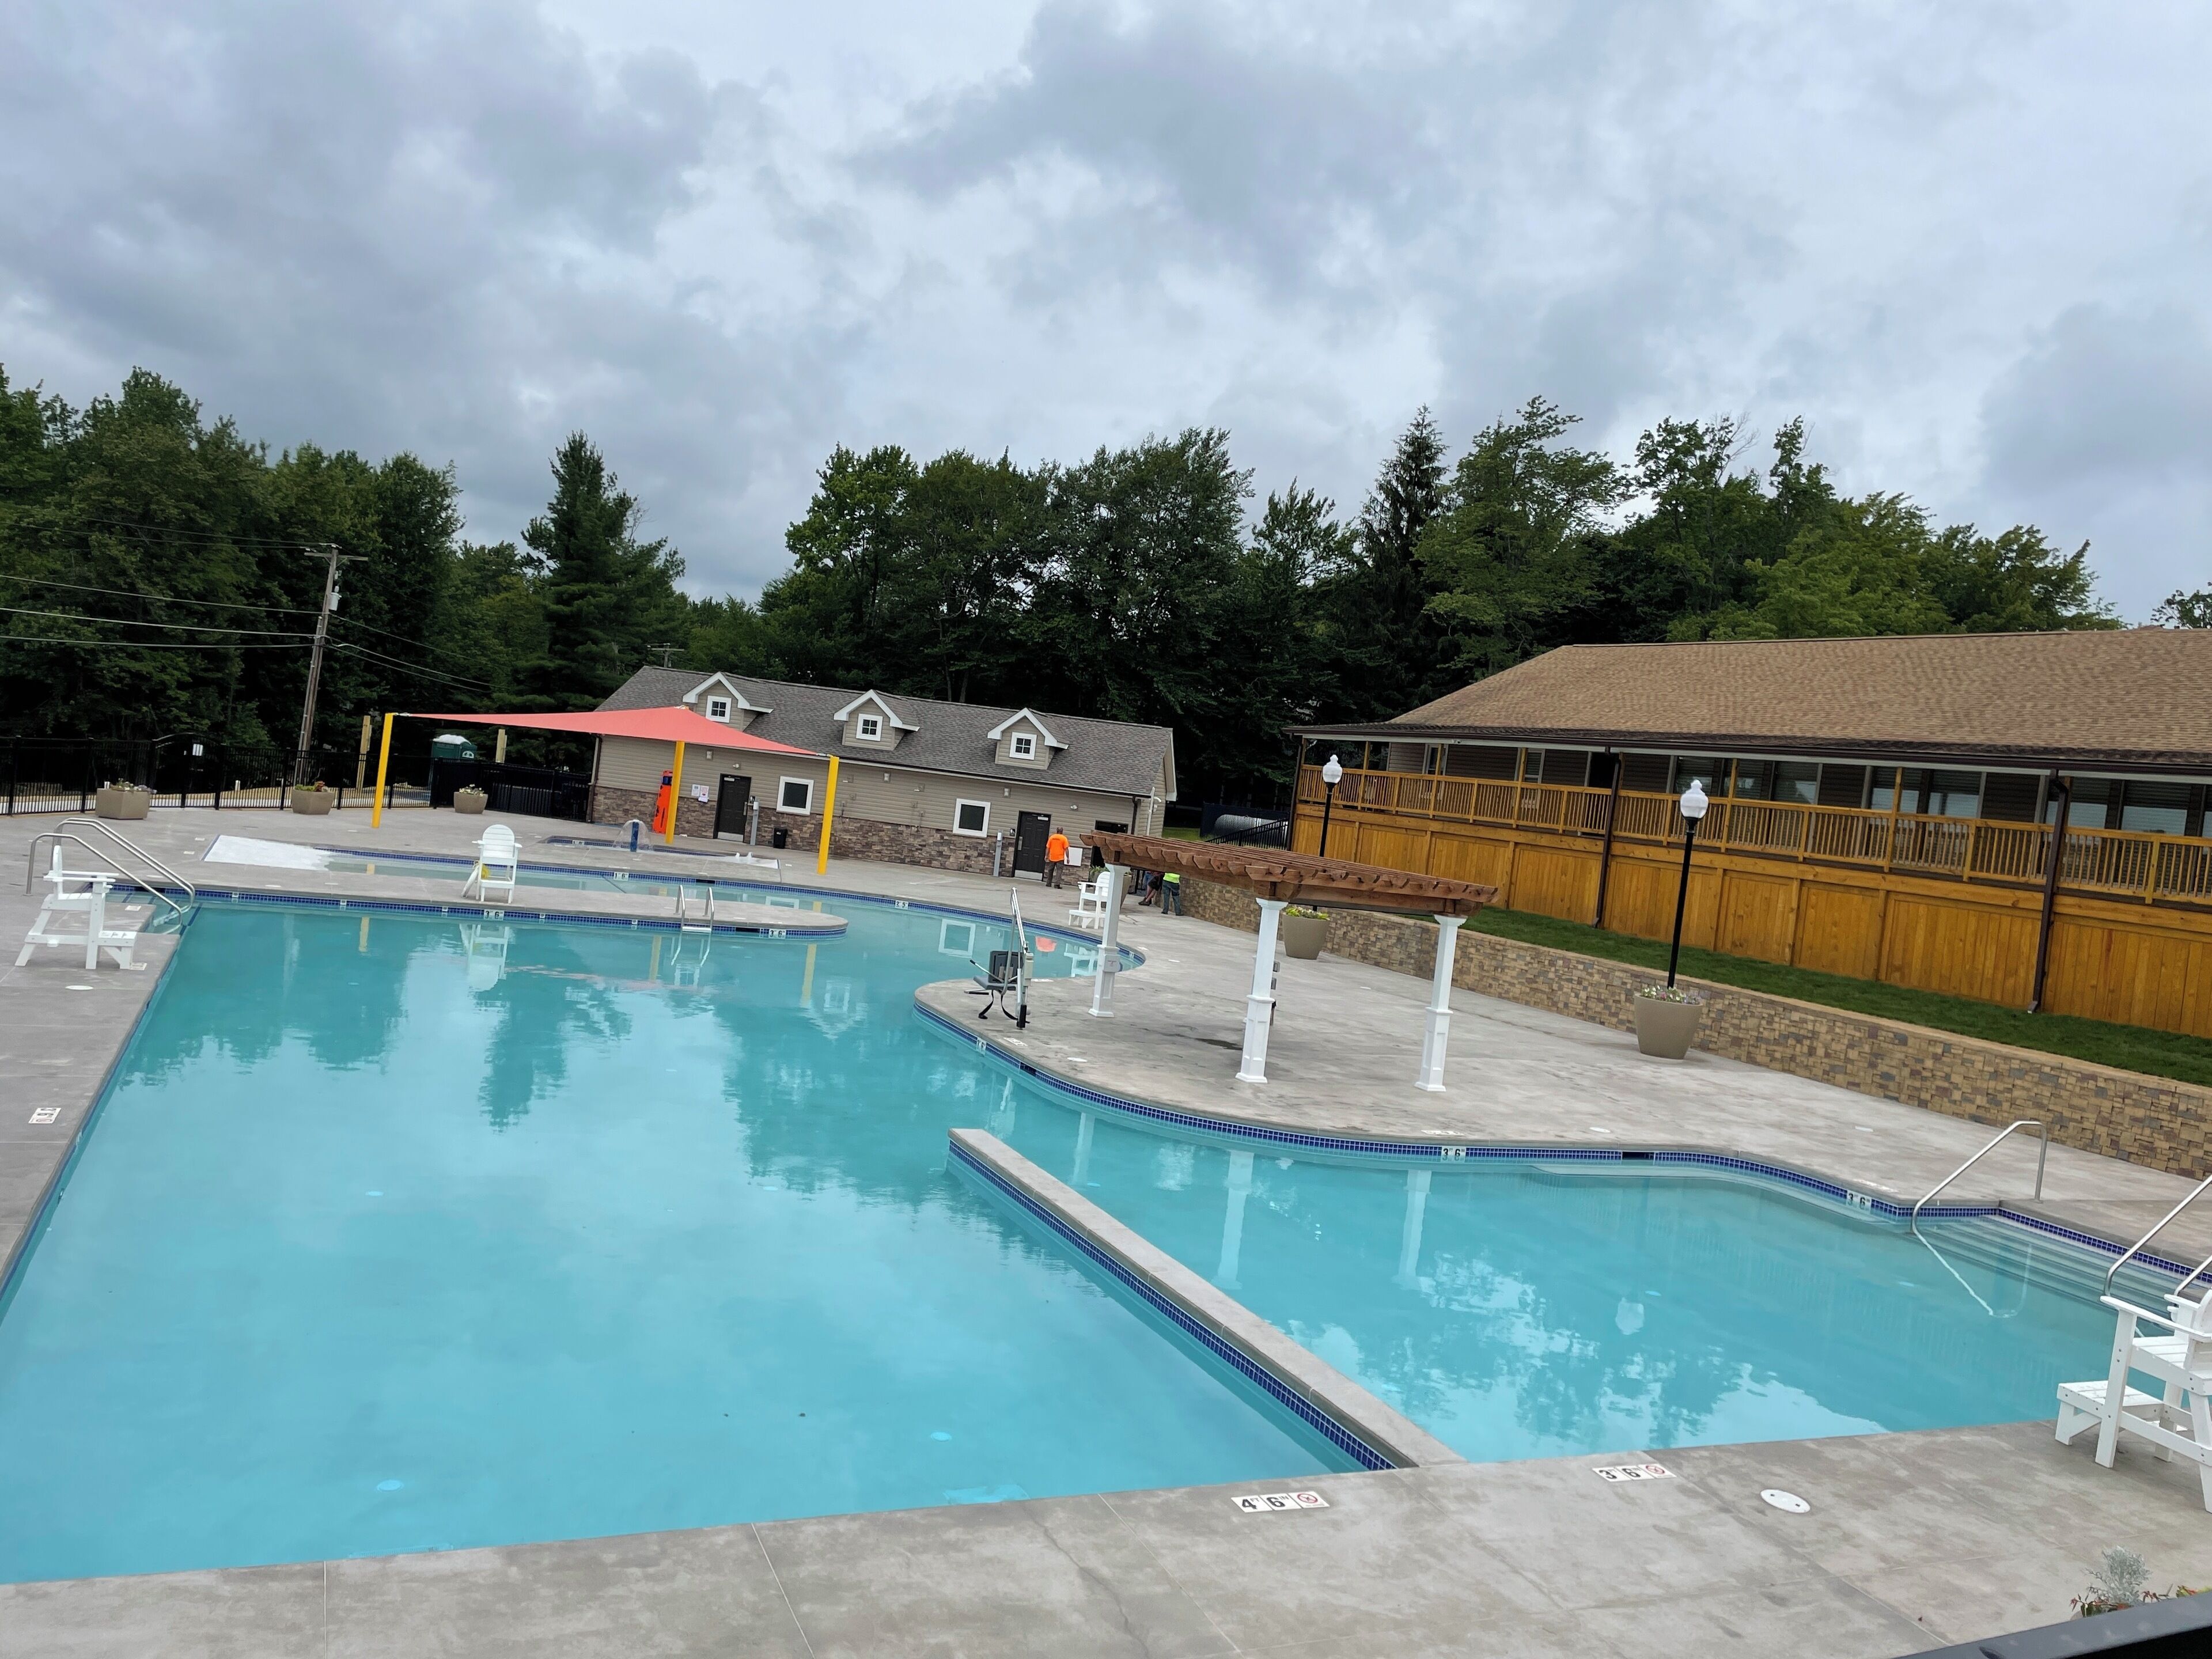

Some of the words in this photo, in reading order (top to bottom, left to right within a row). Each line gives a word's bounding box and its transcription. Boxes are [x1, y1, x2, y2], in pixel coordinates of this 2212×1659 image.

[1442, 1148, 1448, 1158] 3
[1455, 1149, 1460, 1158] 6
[1599, 1469, 1618, 1479] 3
[1622, 1468, 1641, 1478] 6
[1242, 1499, 1257, 1510] 4
[1266, 1497, 1286, 1508] 6
